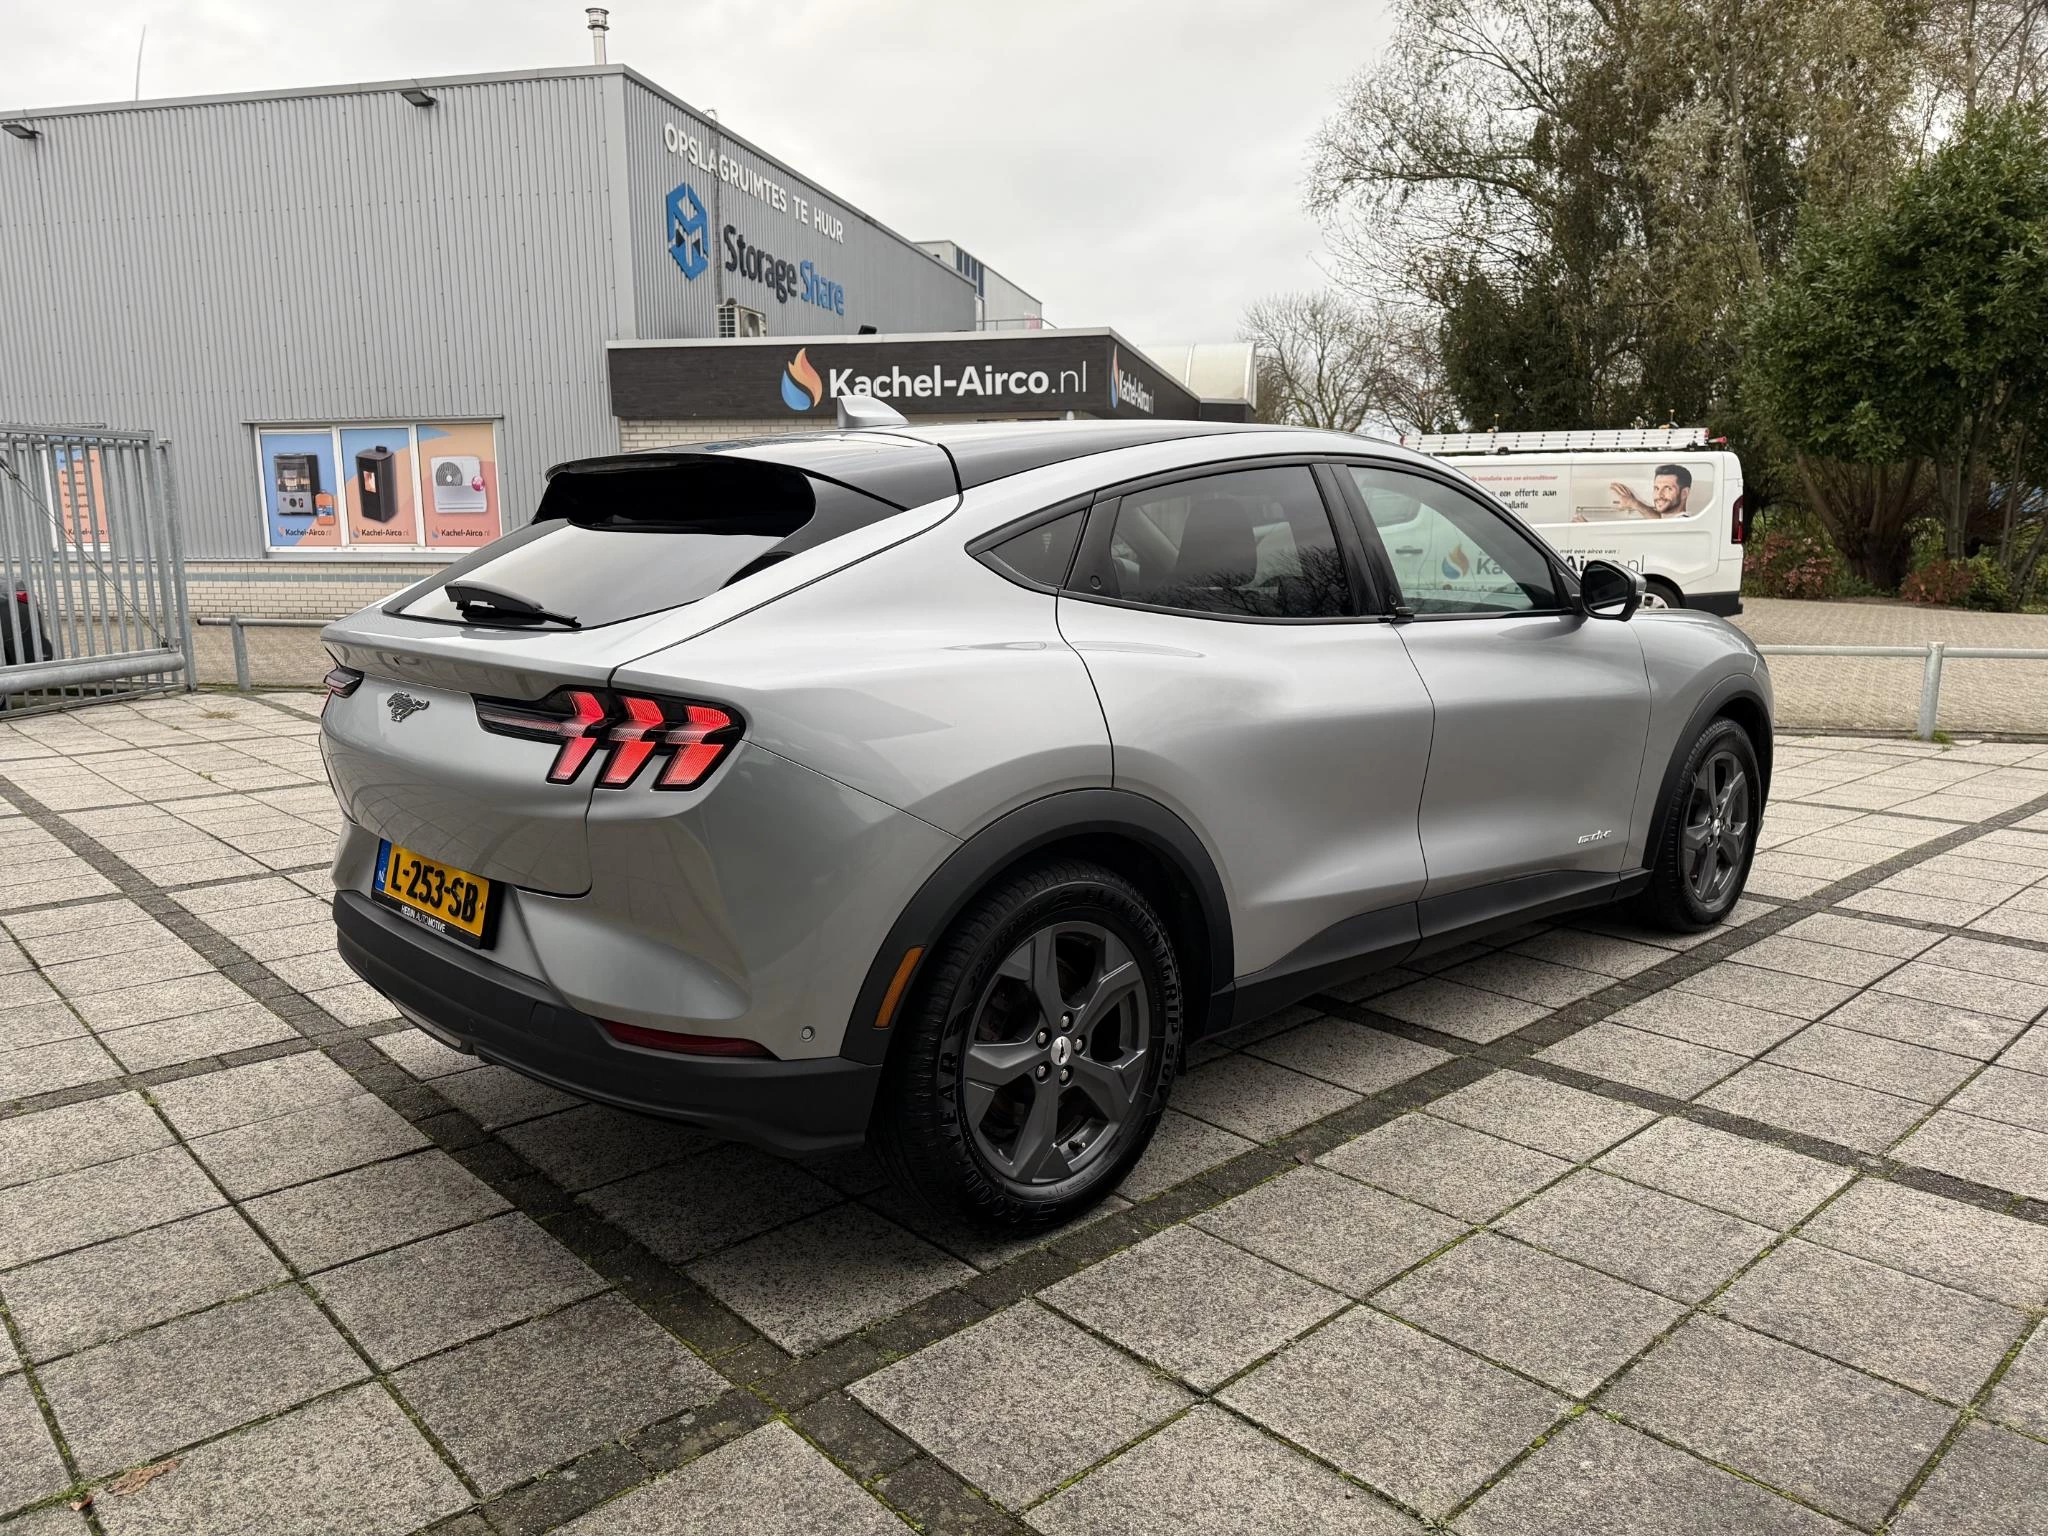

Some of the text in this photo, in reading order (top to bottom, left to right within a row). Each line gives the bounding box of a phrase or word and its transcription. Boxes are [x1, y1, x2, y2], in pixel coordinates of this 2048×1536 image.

[664, 122, 843, 244] OPSLAGRUIMTES TE HUUR
[723, 224, 845, 315] Storage Share
[829, 361, 1087, 398] Kachel-Airco.nl
[1515, 487, 1539, 497] offerte
[390, 853, 479, 922] L-253-SB
